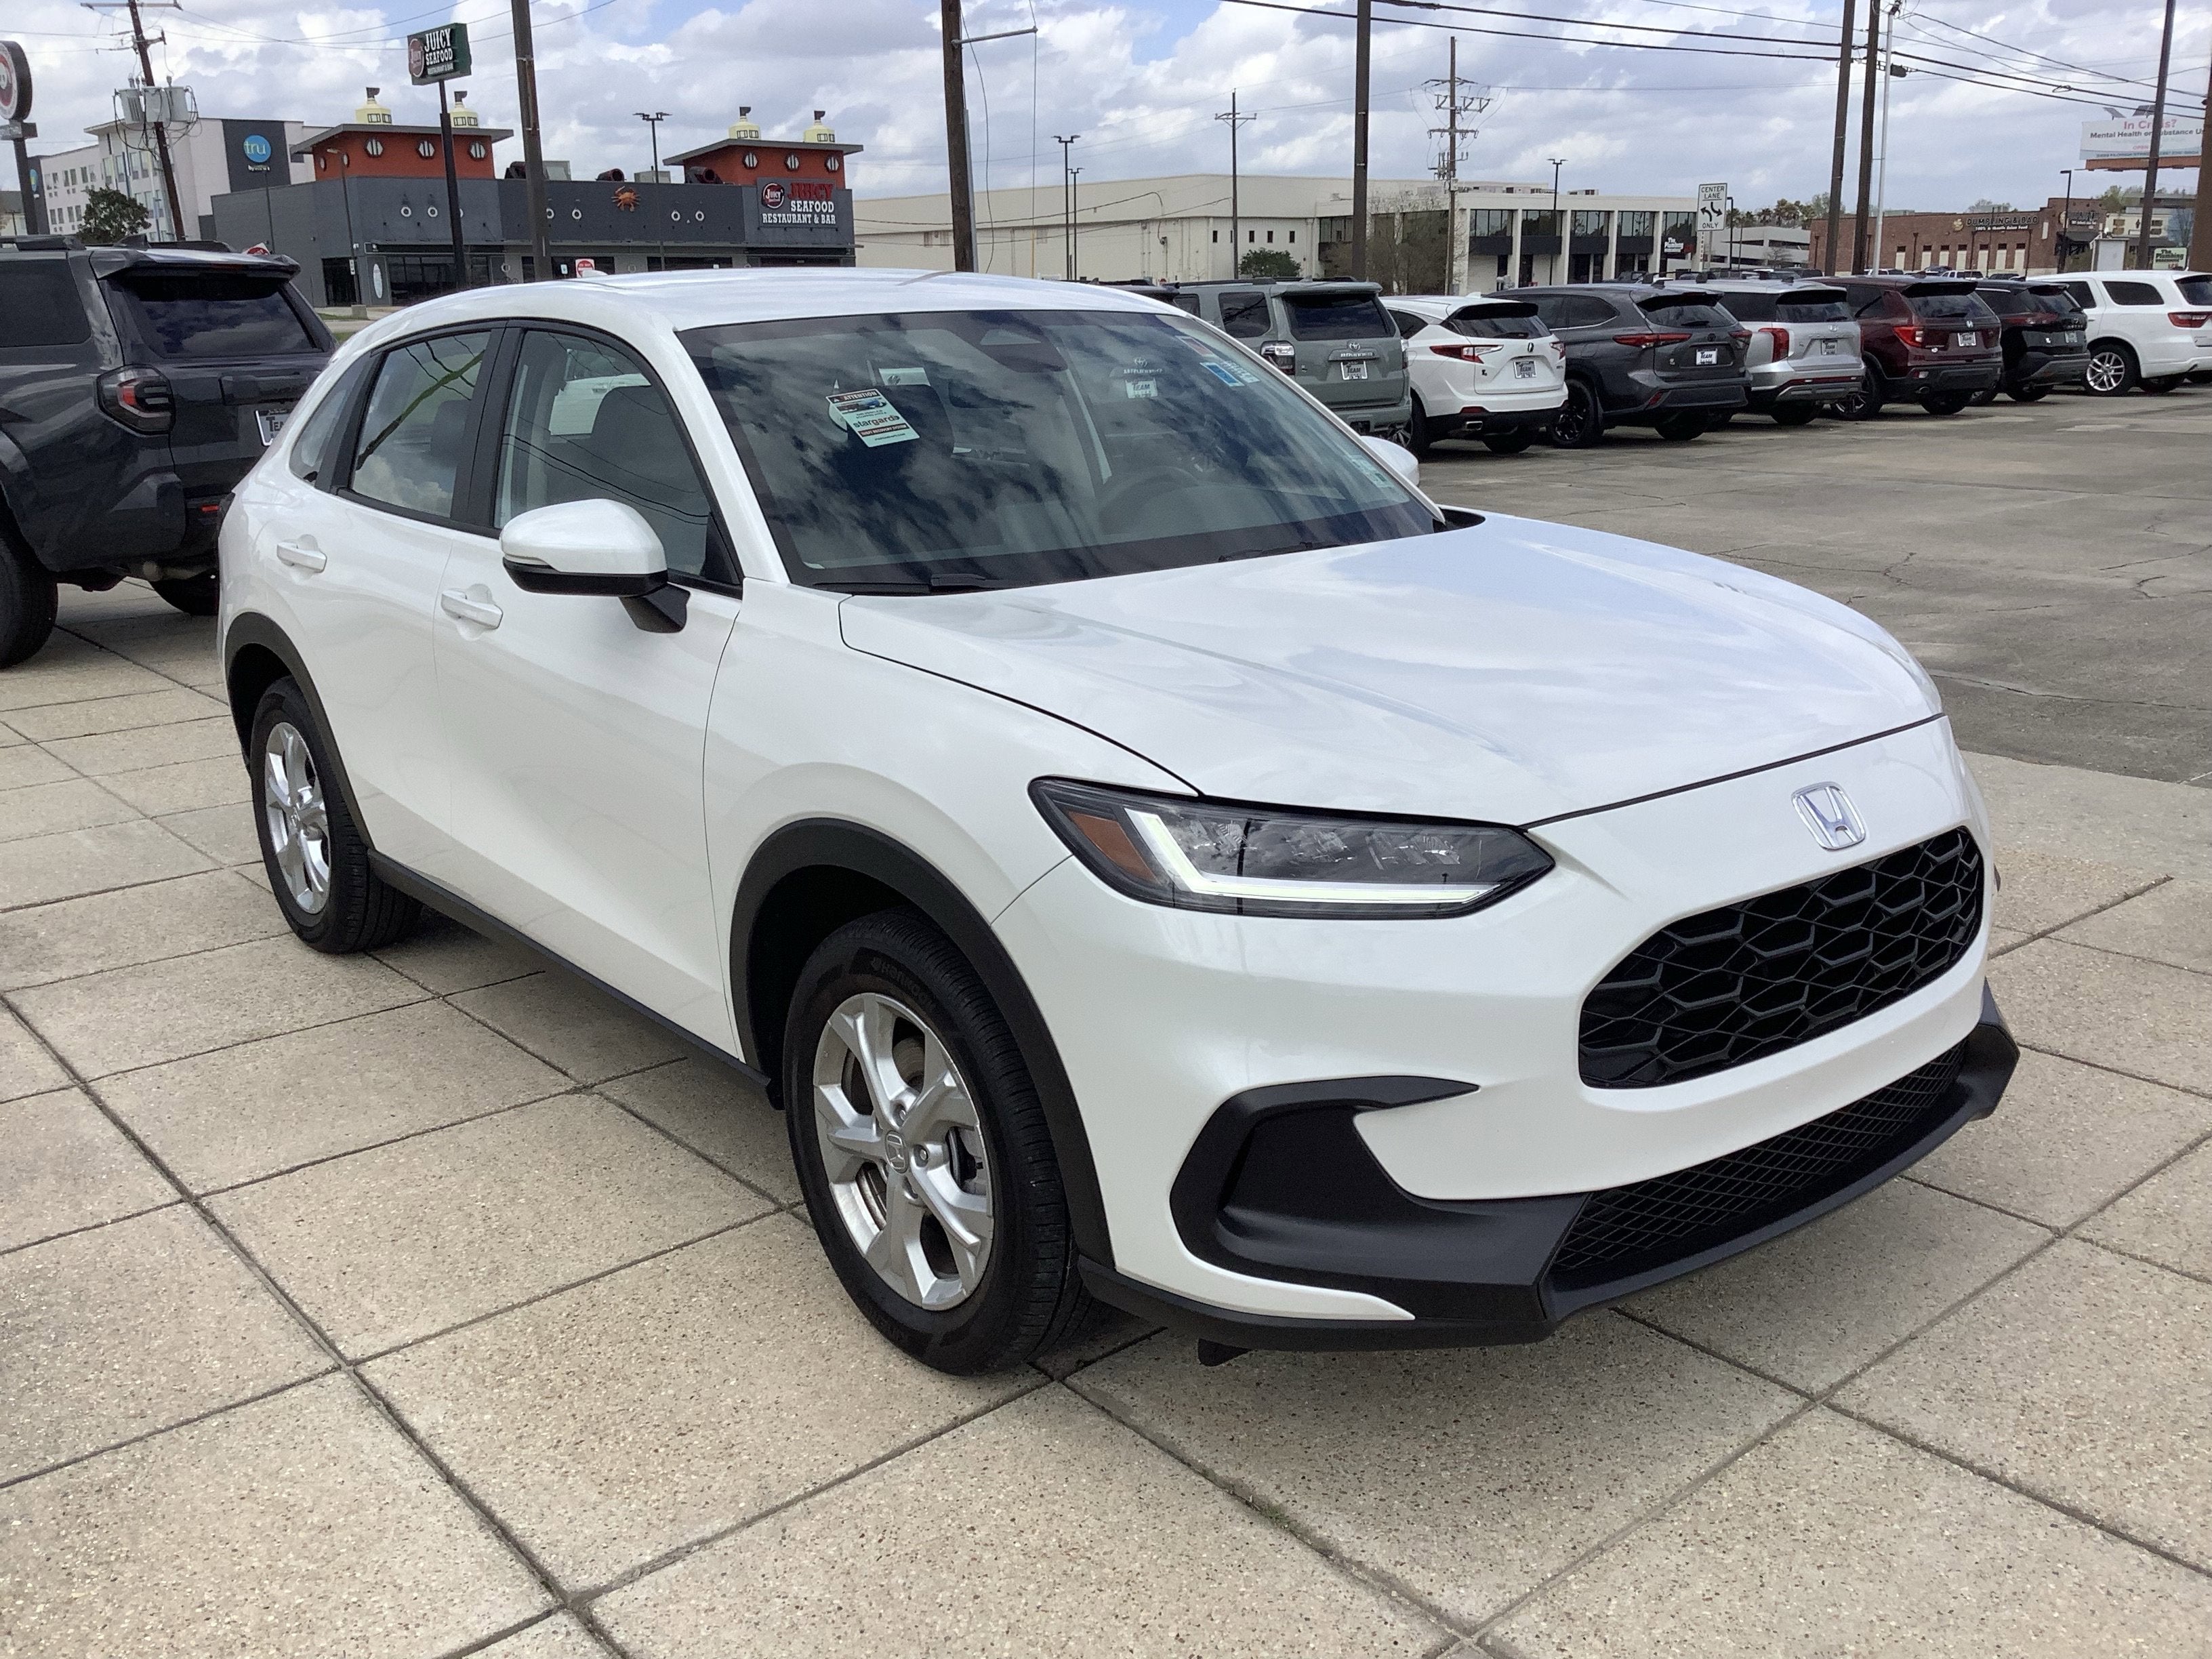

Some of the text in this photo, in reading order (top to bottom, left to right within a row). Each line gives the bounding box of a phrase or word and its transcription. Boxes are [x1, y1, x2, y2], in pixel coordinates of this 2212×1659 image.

[424, 28, 451, 52] JUICY
[425, 47, 453, 66] SEAFOOD
[2124, 121, 2135, 129] In
[244, 141, 266, 155] tru
[787, 182, 834, 201] JUICY
[790, 200, 834, 213] SEAFOOD
[762, 213, 836, 224] RESTAURANT & BAR
[843, 391, 878, 401] ATTENTION
[266, 416, 285, 432] TE
